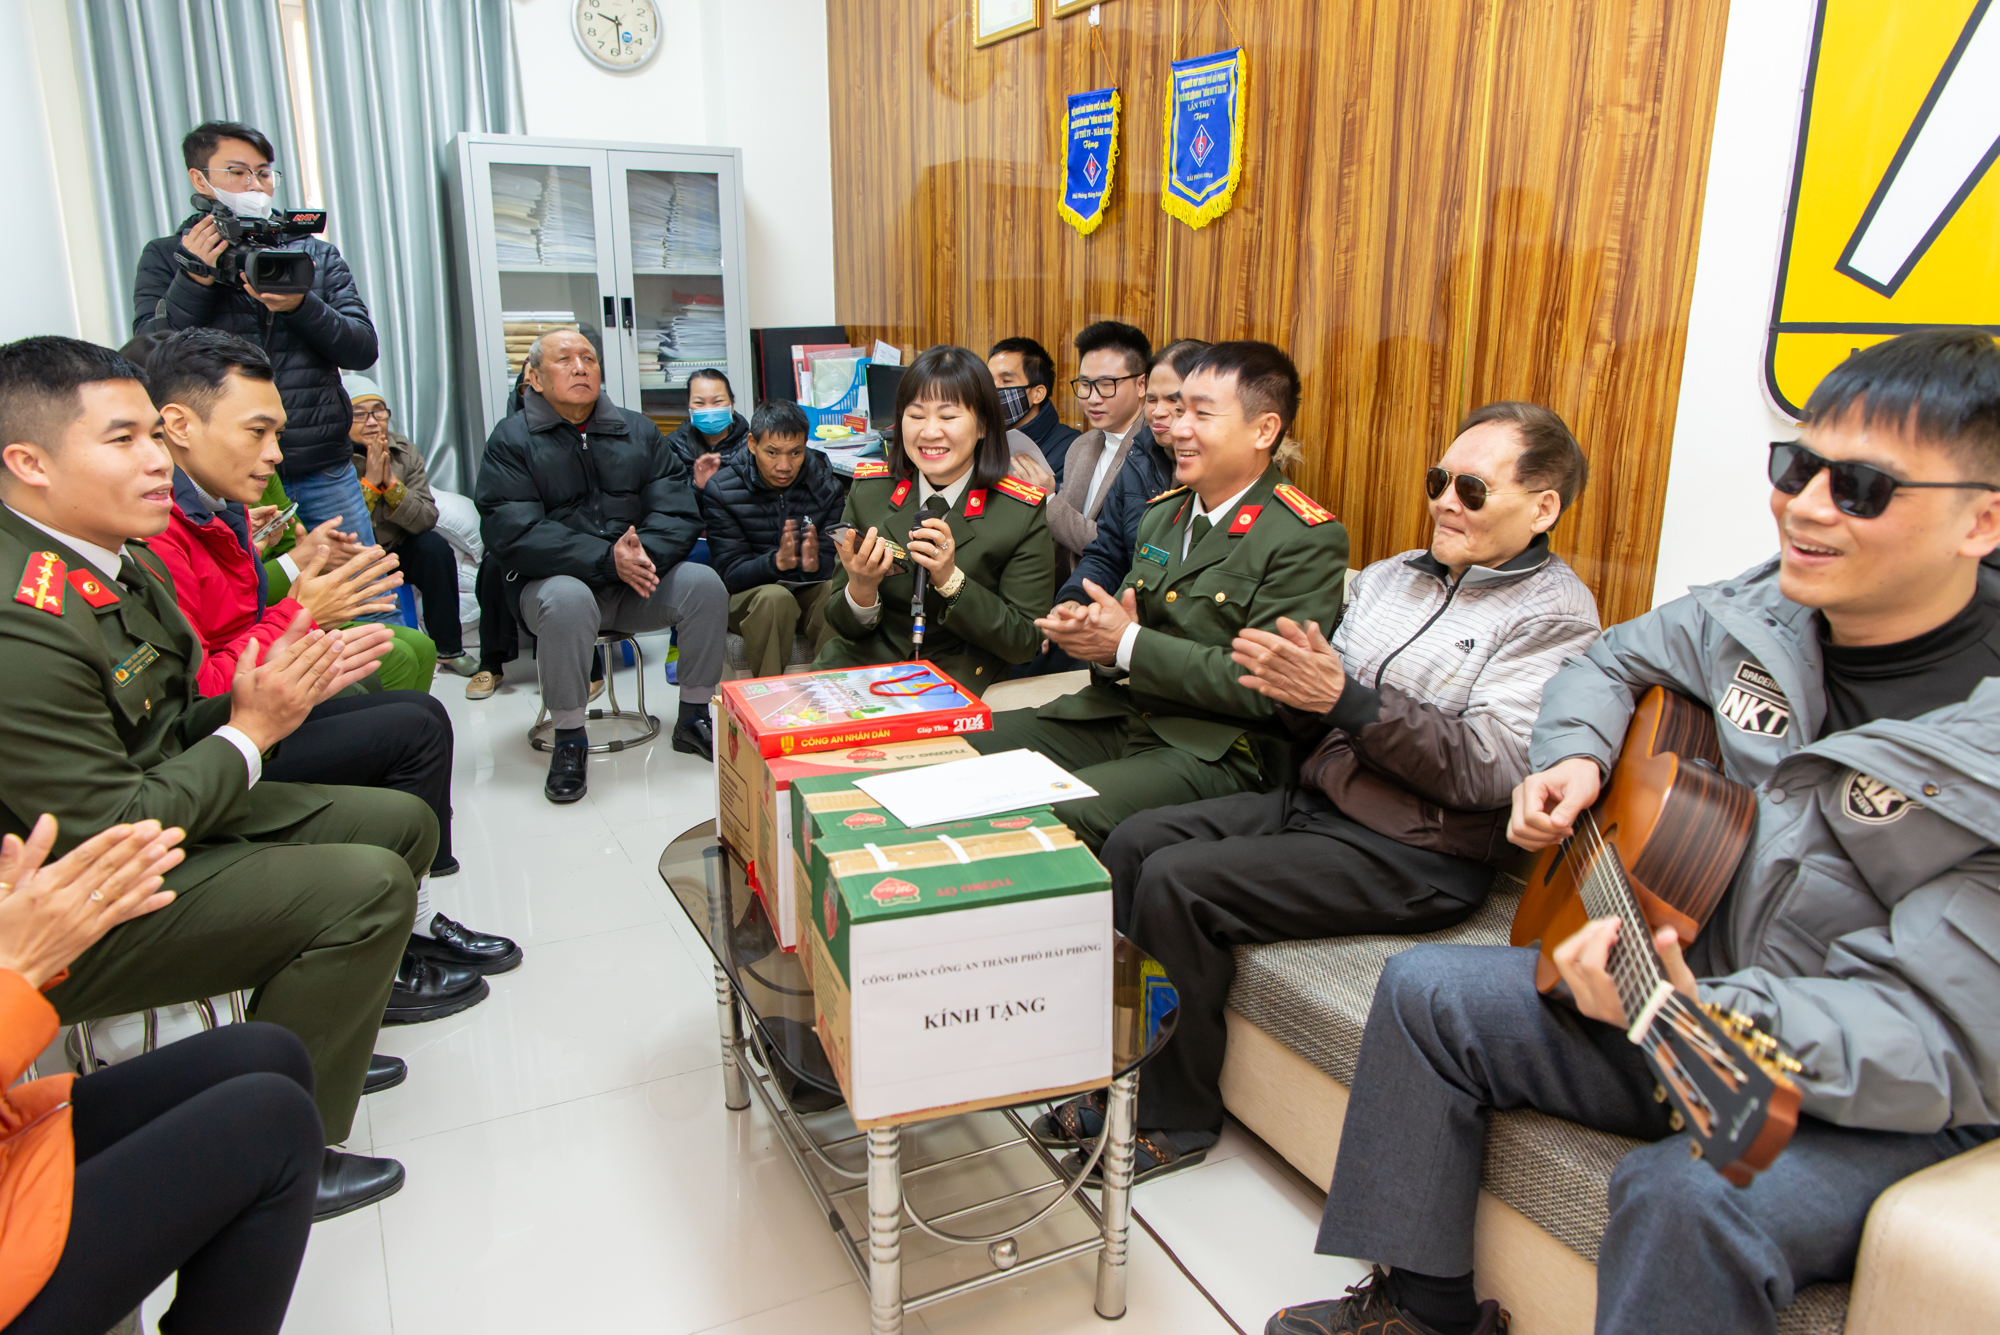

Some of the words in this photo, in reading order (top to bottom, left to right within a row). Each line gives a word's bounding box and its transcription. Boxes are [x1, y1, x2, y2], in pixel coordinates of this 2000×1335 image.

[584, 12, 593, 21] 9
[637, 9, 646, 18] 2
[588, 28, 597, 37] 8
[640, 24, 649, 33] 3
[598, 41, 605, 49] 7
[635, 38, 643, 46] 4
[611, 49, 620, 57] 6
[625, 47, 634, 56] 5
[1740, 668, 1783, 693] SPACEH
[952, 713, 986, 733] 2024
[800, 735, 830, 748] CÔNG
[830, 734, 845, 745] AN
[844, 731, 871, 742] NHÂN
[871, 728, 891, 740] DÂN
[861, 974, 895, 986] CÔNG
[896, 968, 929, 981] ĐOÀN
[930, 964, 962, 976] CÔNG
[964, 962, 980, 971] AN
[982, 955, 1019, 969] THÀNH
[1065, 942, 1103, 956] PHÒNG
[924, 1004, 981, 1031] KÍNH
[985, 997, 1047, 1022] TẶNG
